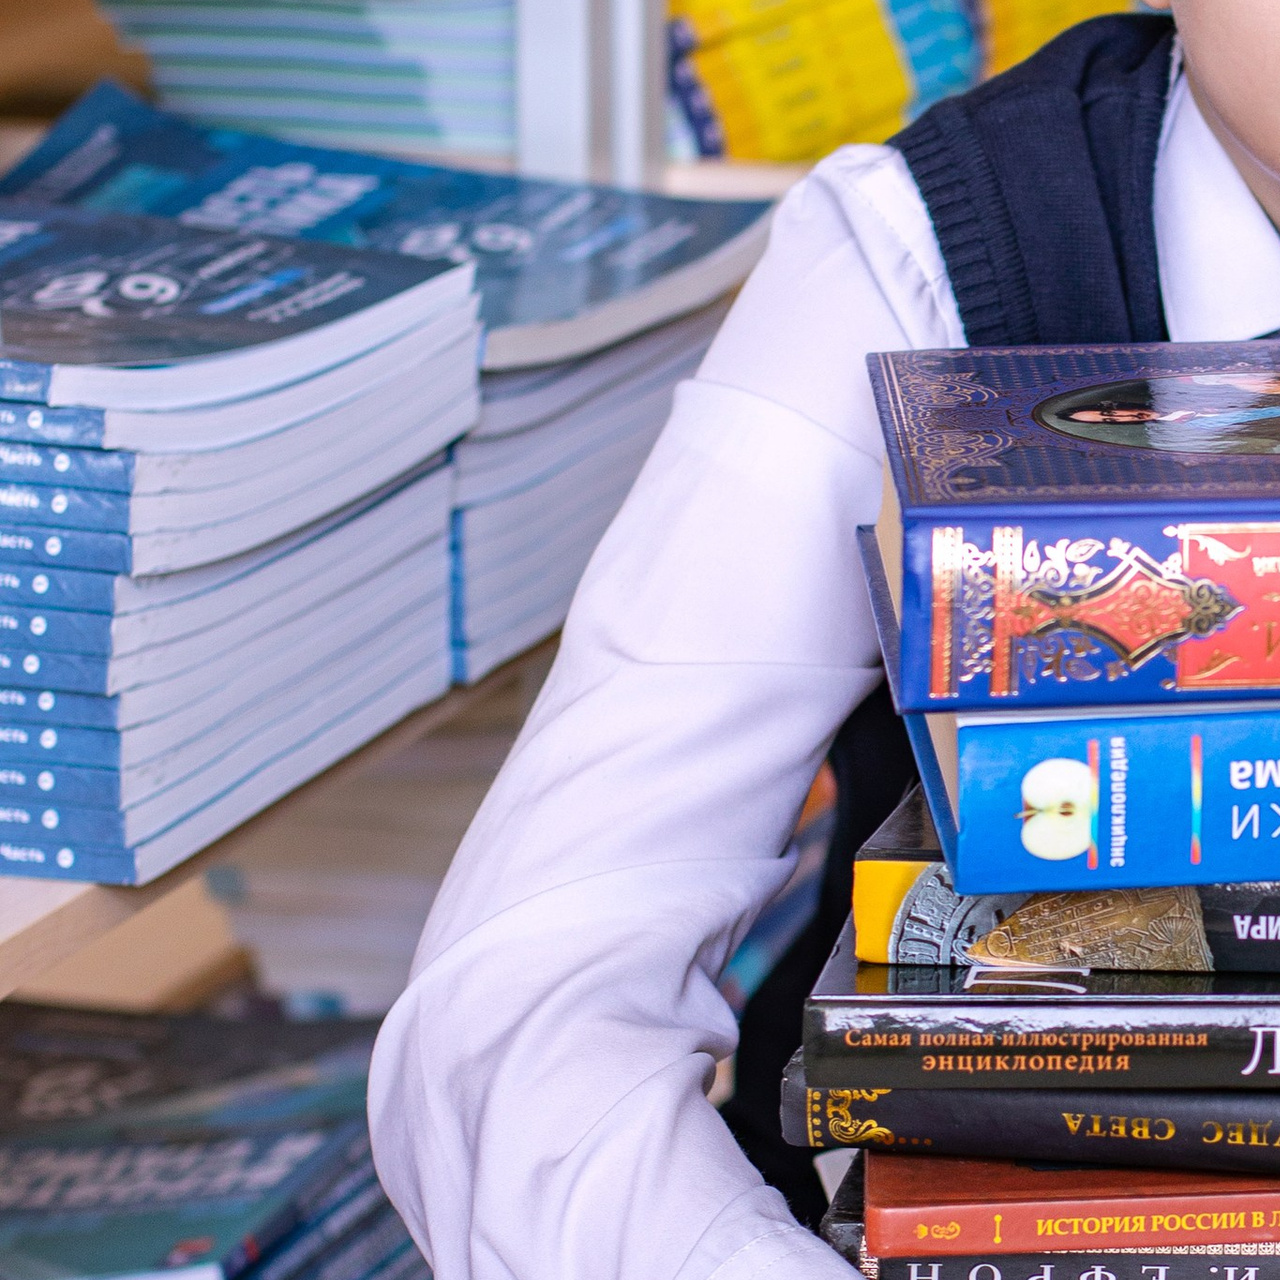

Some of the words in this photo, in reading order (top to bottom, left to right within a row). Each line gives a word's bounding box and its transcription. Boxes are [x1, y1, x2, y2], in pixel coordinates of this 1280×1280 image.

[1109, 736, 1129, 868] энциклопедия
[844, 1028, 912, 1048] Самая
[919, 1030, 996, 1048] полная
[1002, 1029, 1209, 1051] иллюстрированная
[921, 1051, 1130, 1072] энциклопедия
[1061, 1112, 1175, 1141] СВЕТА
[1036, 1215, 1146, 1237] ИСТОРИЯ
[1151, 1212, 1247, 1233] РОССИИ
[1251, 1211, 1264, 1229] В
